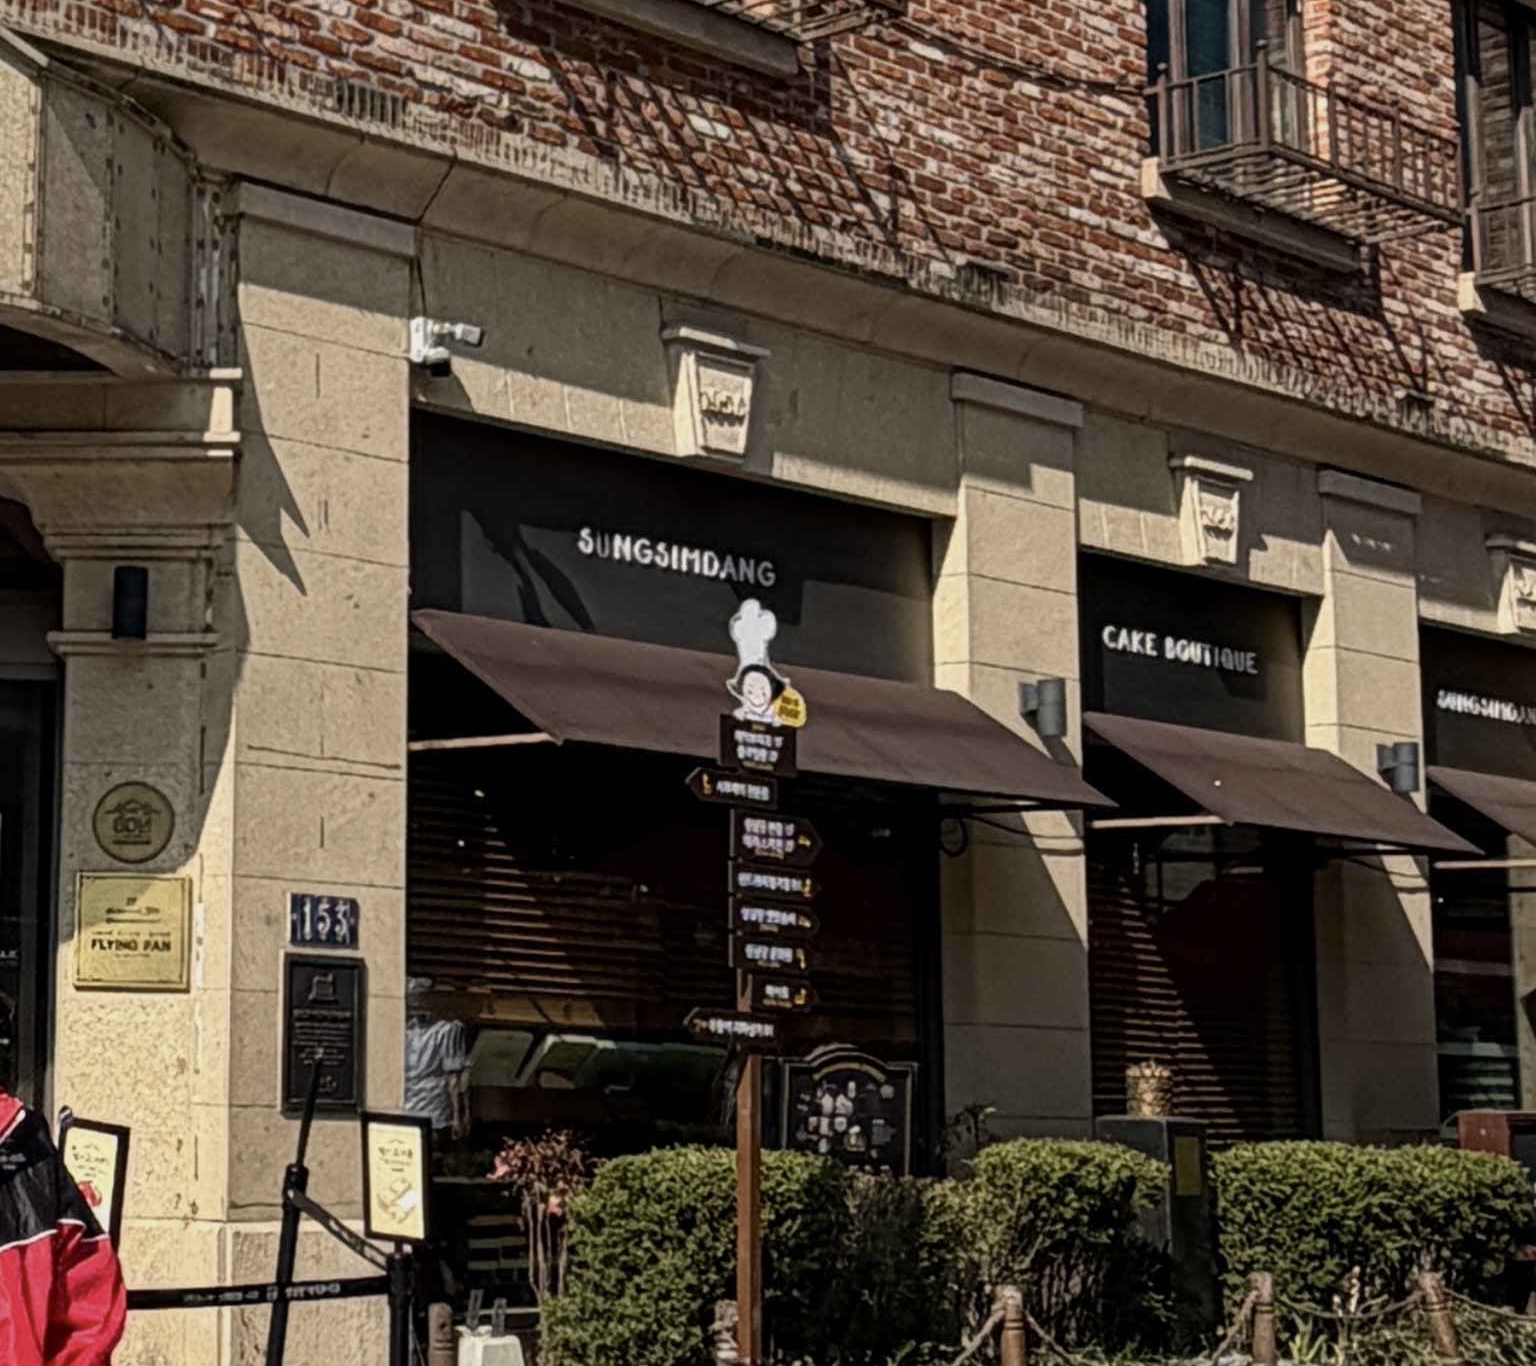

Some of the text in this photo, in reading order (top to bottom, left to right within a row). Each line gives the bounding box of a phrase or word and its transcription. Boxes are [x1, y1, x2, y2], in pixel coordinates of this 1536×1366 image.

[577, 527, 777, 587] SUNGSIMDANG
[1102, 625, 1259, 675] CAKE BOUTIQUE
[303, 897, 348, 943] 153
[91, 938, 172, 952] FLYING PAN
